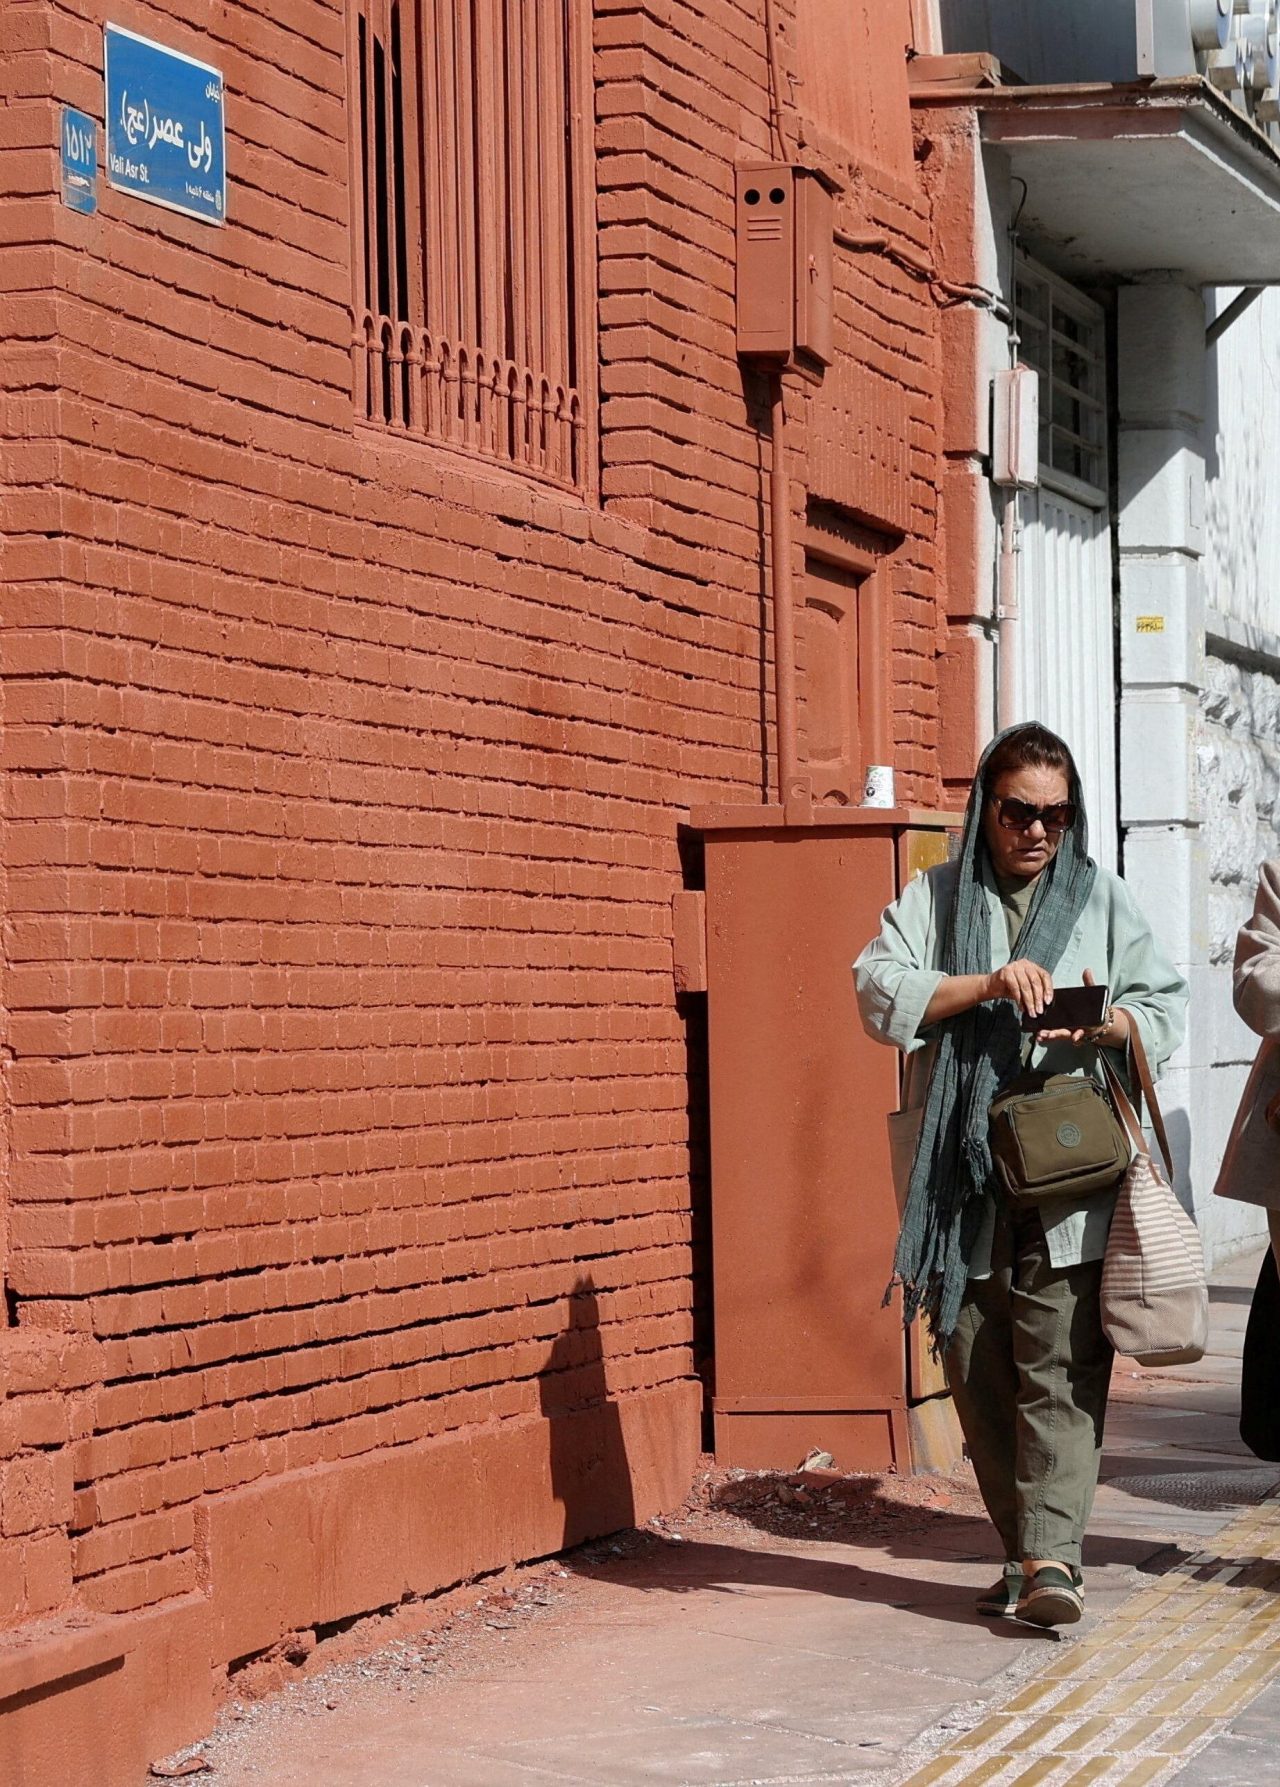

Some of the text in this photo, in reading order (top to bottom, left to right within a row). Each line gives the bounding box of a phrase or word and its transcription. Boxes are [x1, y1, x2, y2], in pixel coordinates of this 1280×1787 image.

[148, 115, 184, 149] عصر
[187, 120, 212, 173] ولی
[110, 152, 150, 184] Vali Asr St.
